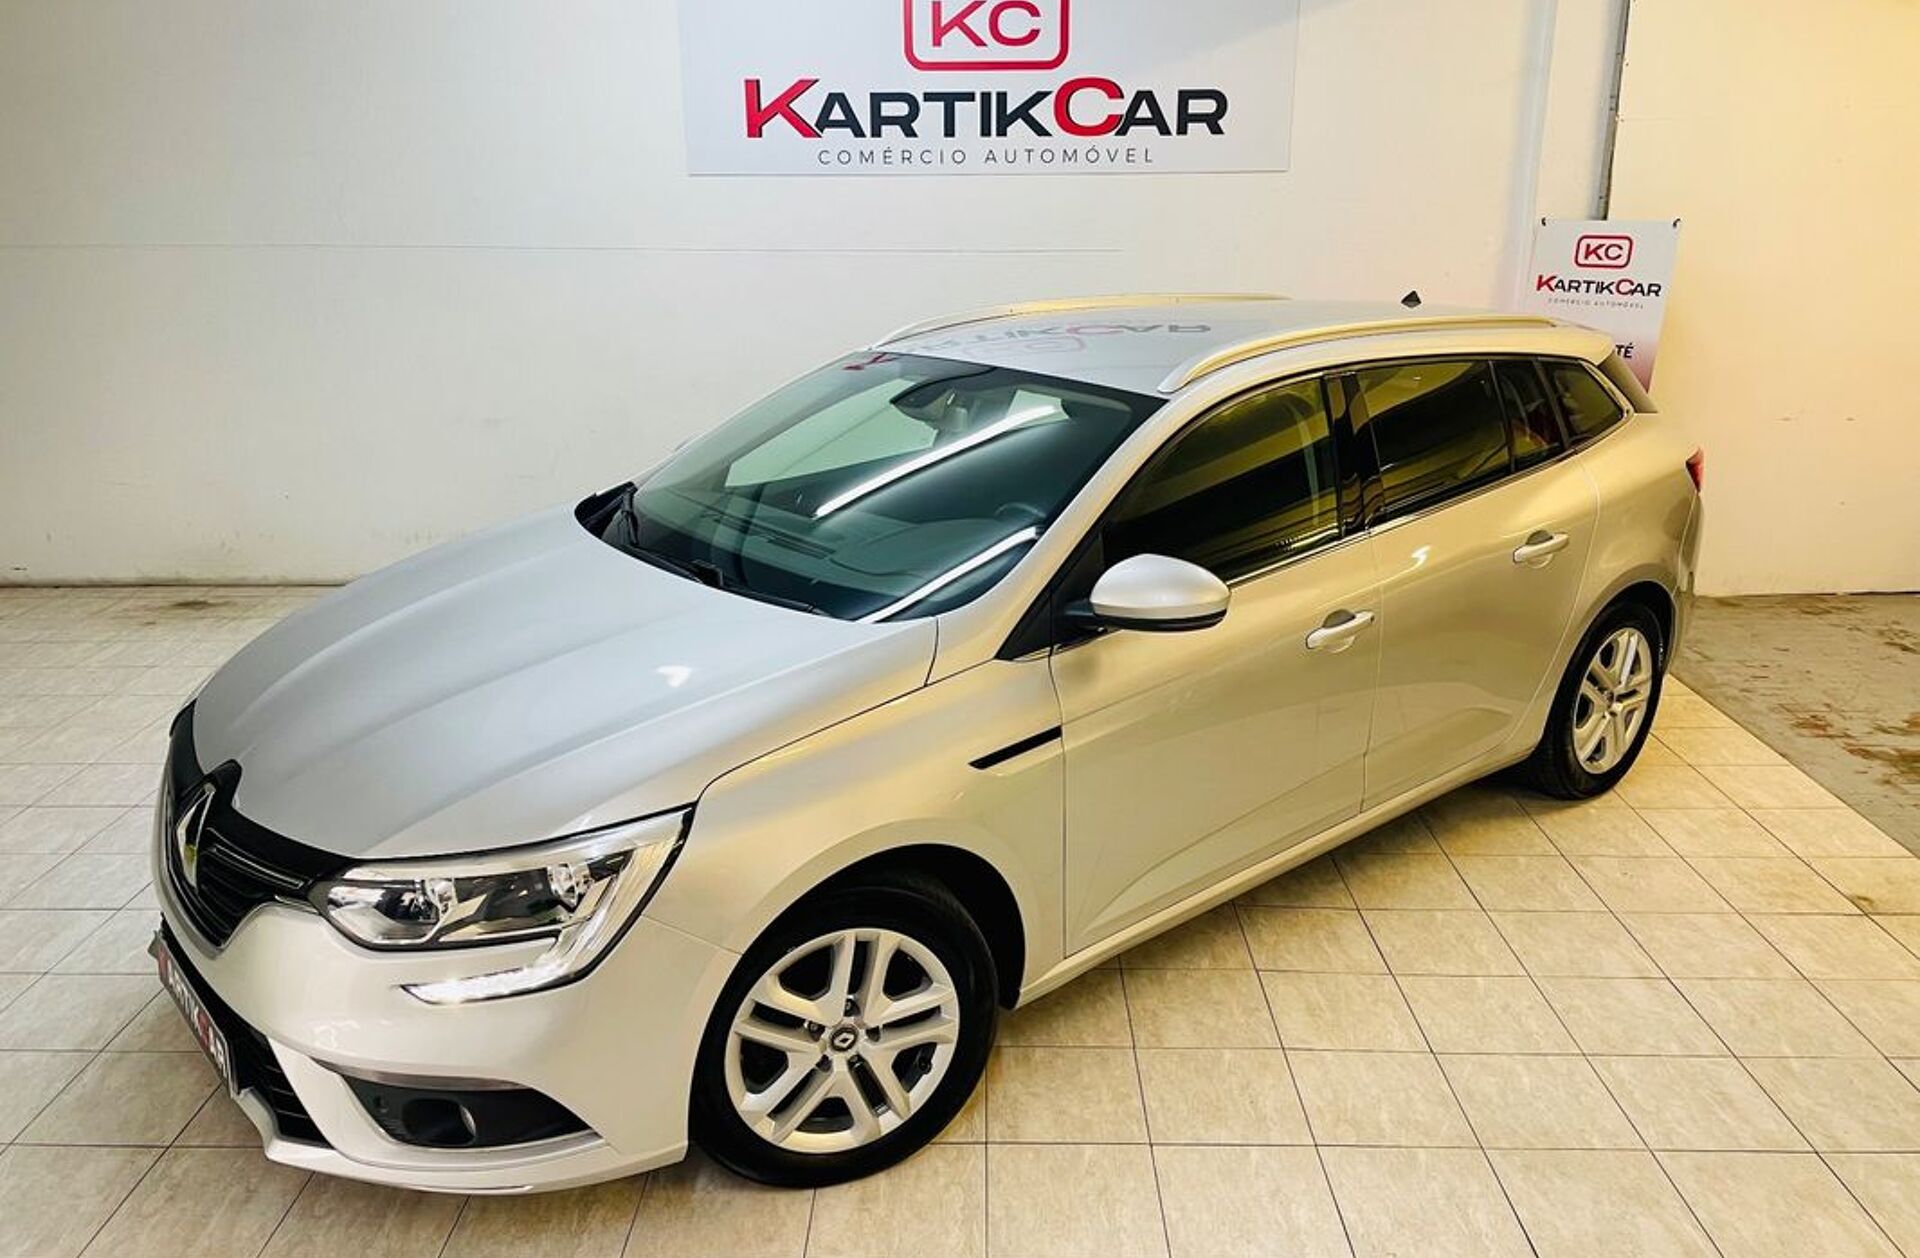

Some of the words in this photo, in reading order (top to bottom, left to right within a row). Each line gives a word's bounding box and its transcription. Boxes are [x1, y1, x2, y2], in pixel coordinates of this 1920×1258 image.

[932, 0, 1041, 47] KC
[744, 77, 1228, 138] KARTIKCAR
[818, 147, 966, 166] COMÉRCIO
[984, 144, 1153, 164] AUTOMÓVEL
[1583, 243, 1623, 261] KC
[1536, 274, 1662, 297] KARTIKCAR
[1615, 342, 1634, 359] TÉ
